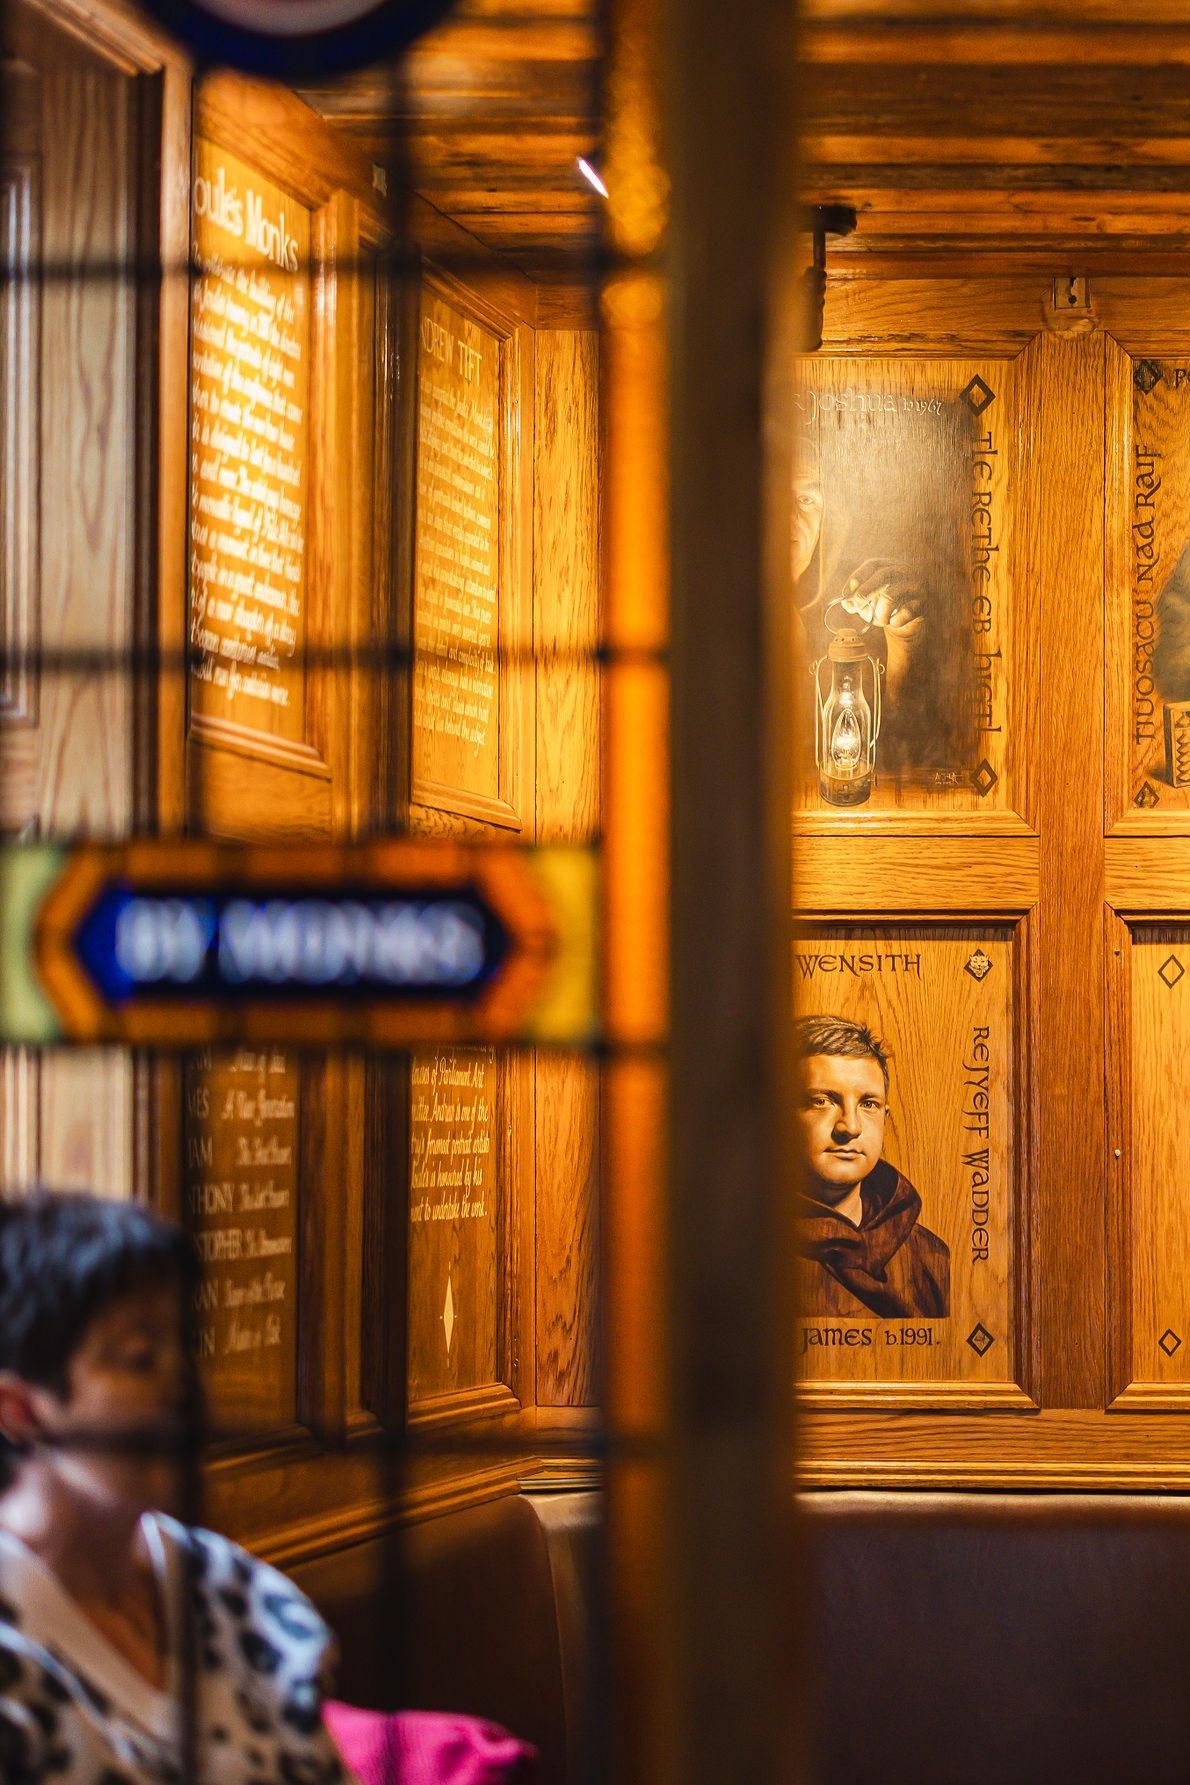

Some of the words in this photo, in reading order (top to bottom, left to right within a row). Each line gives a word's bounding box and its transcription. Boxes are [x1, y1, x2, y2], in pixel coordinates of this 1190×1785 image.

[245, 188, 298, 273] Monks
[457, 340, 483, 387] TIFT
[972, 596, 991, 634] EB
[961, 1026, 989, 1139] REJYEFF
[430, 1091, 454, 1123] Andrew
[478, 1096, 488, 1122] the
[464, 1158, 471, 1198] by
[473, 1155, 482, 1185] his
[461, 1193, 469, 1218] the
